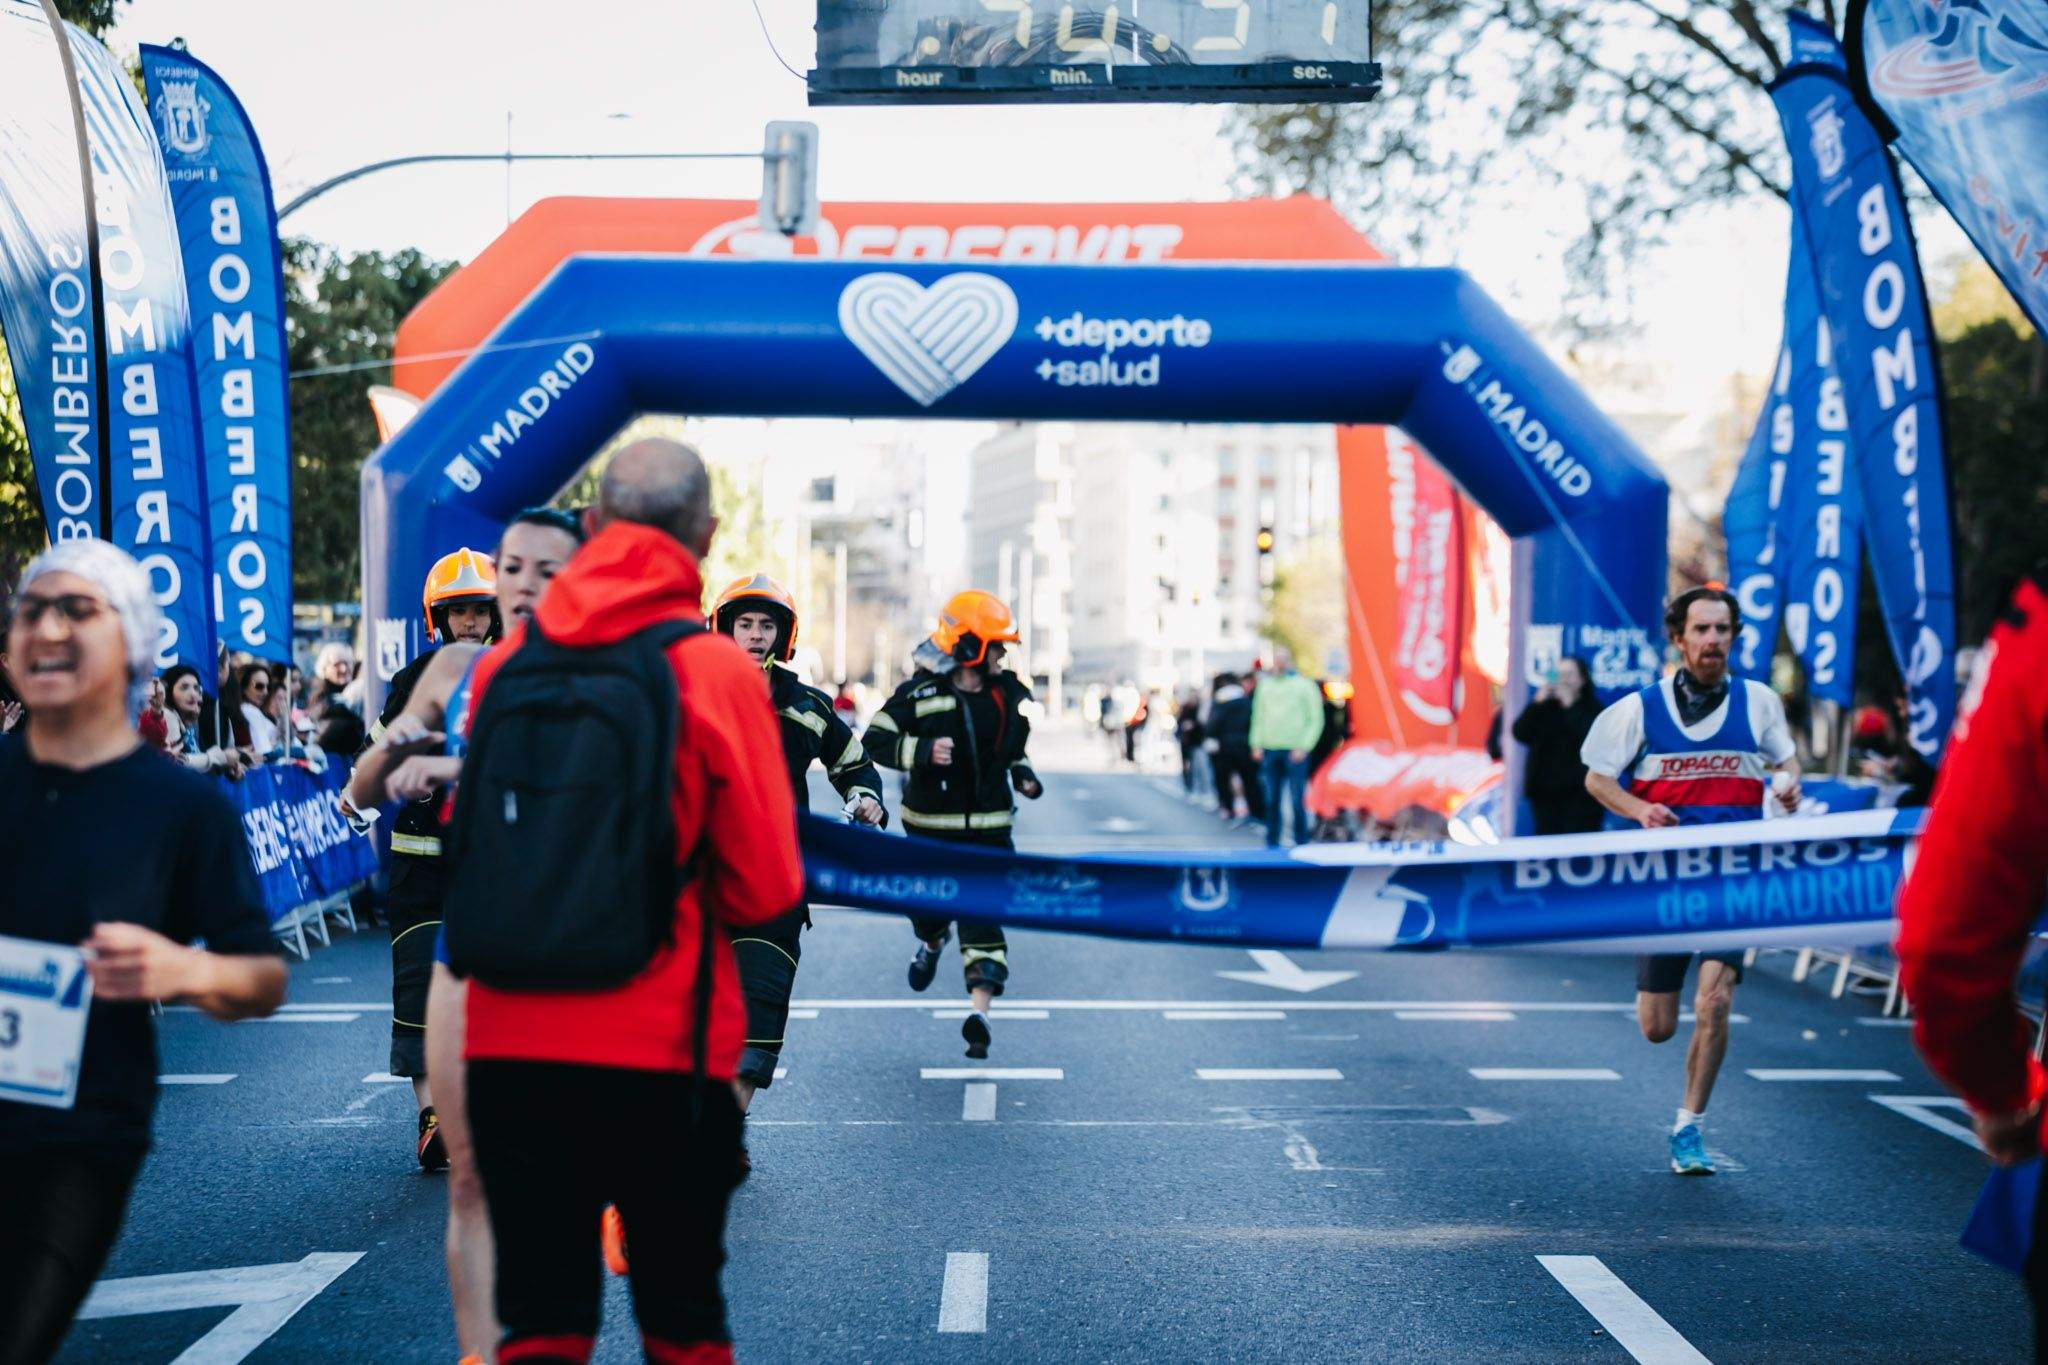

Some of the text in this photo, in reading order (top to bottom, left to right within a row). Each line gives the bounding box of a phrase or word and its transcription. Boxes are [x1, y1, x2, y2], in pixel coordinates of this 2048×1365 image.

[896, 69, 944, 87] hour
[1050, 69, 1093, 85] min.
[1292, 64, 1334, 80] sec.
[1035, 312, 1212, 353] +deporte
[1035, 353, 1161, 387] +salud
[479, 341, 596, 460] MADRID
[1475, 380, 1592, 497] MADRID
[1659, 755, 1741, 775] TOPACIO
[1658, 860, 1894, 928] de MADRID
